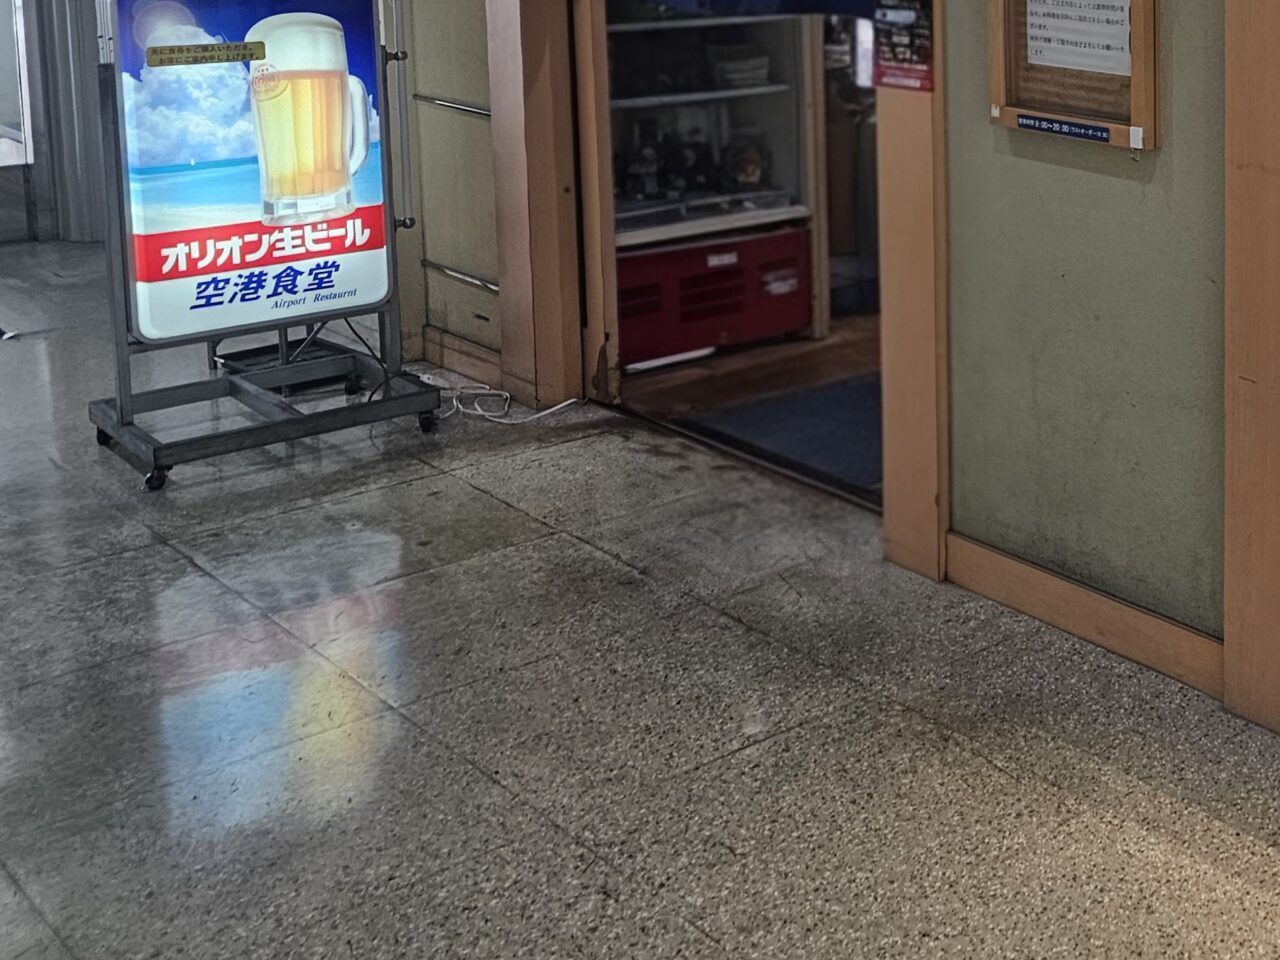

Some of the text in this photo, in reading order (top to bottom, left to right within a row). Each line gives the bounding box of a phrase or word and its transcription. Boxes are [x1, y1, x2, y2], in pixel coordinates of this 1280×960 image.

[161, 218, 371, 274] オリオン生ビール
[190, 260, 341, 310] 空港食堂
[271, 295, 307, 310] Airport
